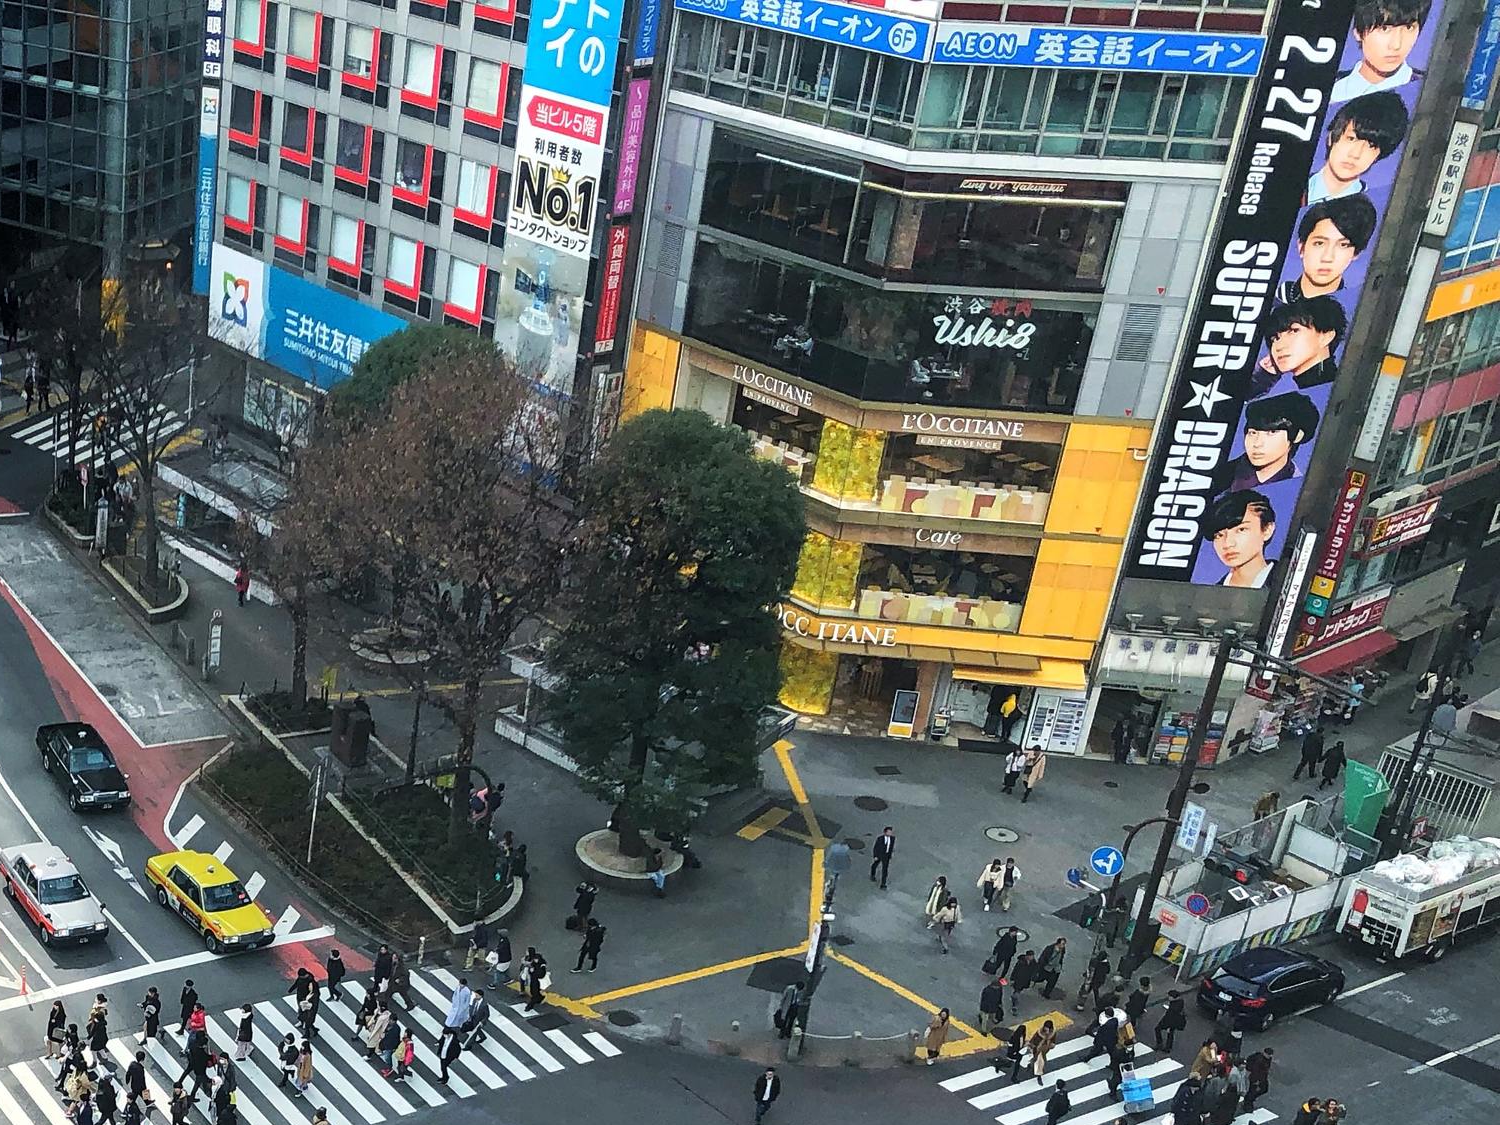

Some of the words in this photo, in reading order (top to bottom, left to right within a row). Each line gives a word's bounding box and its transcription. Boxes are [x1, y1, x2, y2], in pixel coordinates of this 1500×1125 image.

[642, 0, 656, 54] アイシティ
[890, 27, 915, 48] 6F
[205, 64, 219, 74] 5F
[944, 32, 1018, 58] AEON
[1034, 32, 1255, 69] 英会話イーオン
[1260, 34, 1337, 142] 2.27
[535, 102, 597, 138] 当ビル5階
[534, 137, 583, 167] 利用者数
[512, 154, 597, 236] No.1
[1238, 142, 1281, 216] Release
[1431, 132, 1470, 226] 渋谷駅前ビル
[616, 199, 631, 211] 4F
[509, 216, 589, 253] コンタクトショップ
[1192, 239, 1279, 371] SUPER
[283, 337, 317, 360] SUMITOMO
[932, 314, 1037, 350] Ushi8
[732, 363, 813, 408] L'OCCITANE
[901, 412, 1025, 438] L'OCCITANE
[939, 438, 1000, 450] PROVENCE
[1138, 419, 1229, 569] DRAGON
